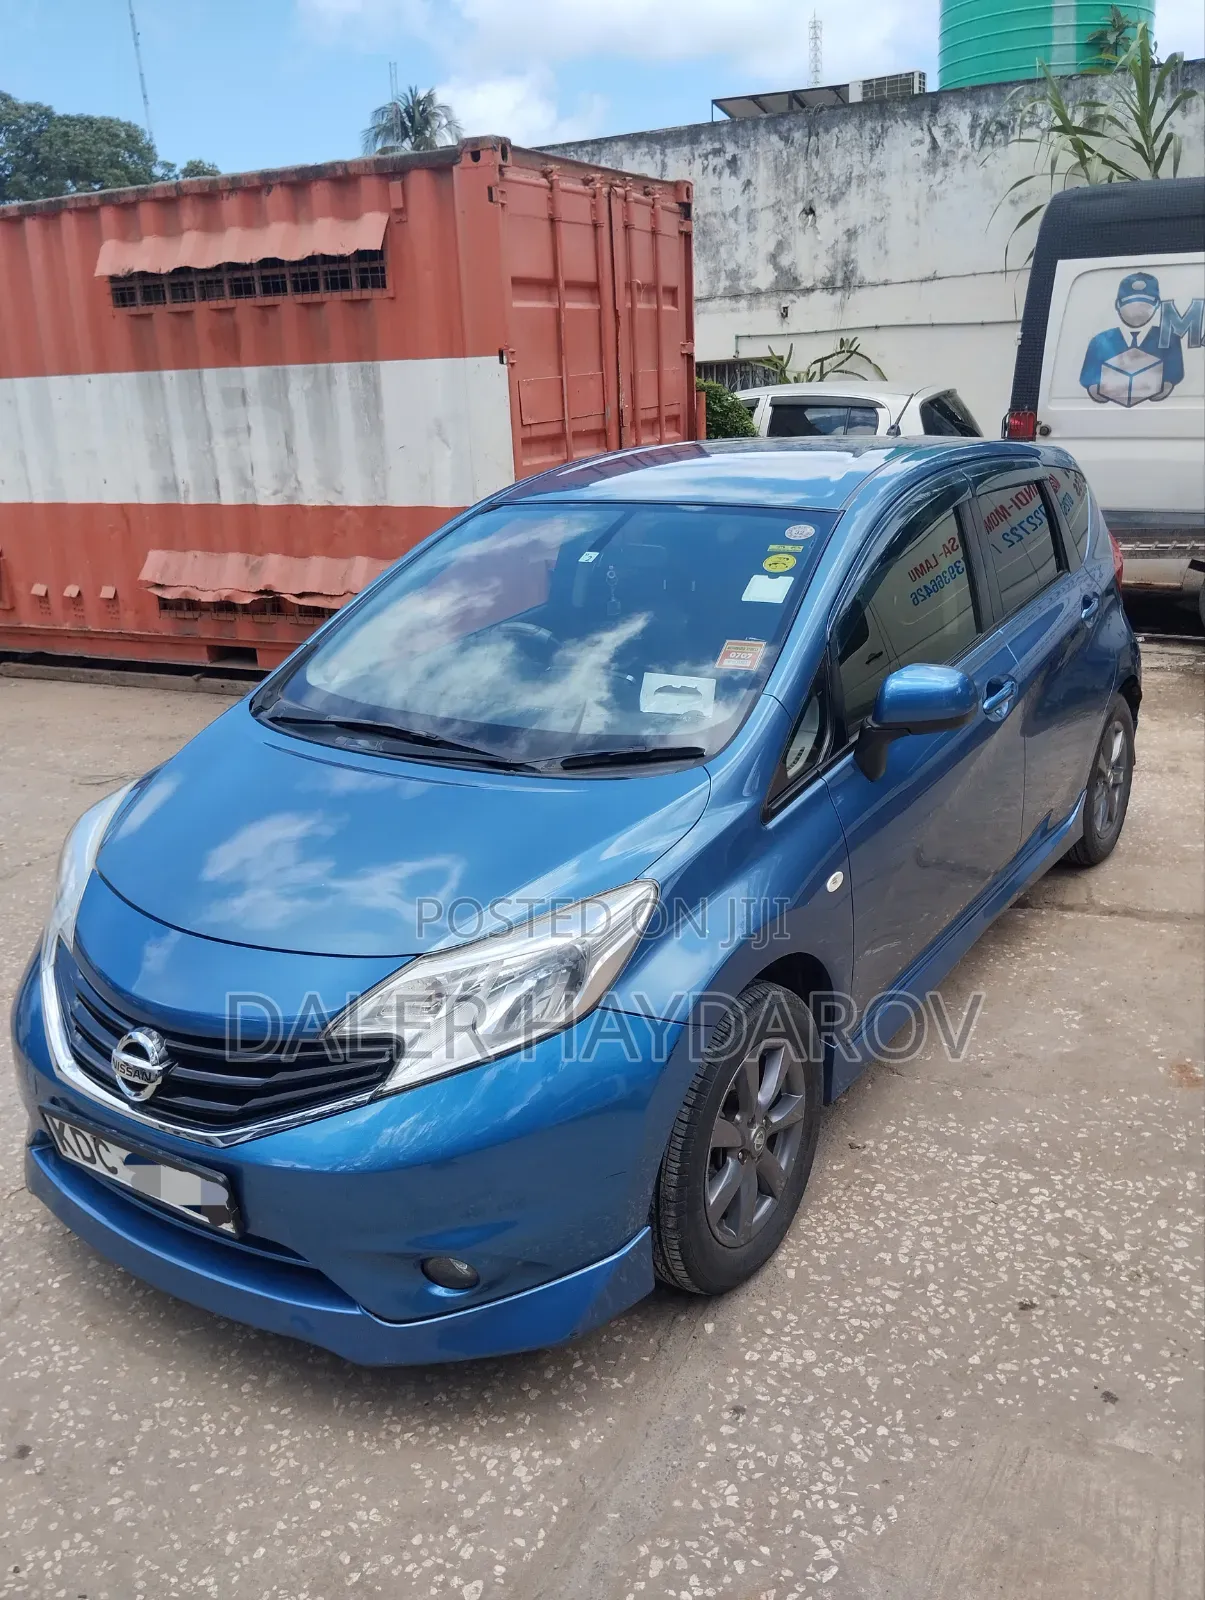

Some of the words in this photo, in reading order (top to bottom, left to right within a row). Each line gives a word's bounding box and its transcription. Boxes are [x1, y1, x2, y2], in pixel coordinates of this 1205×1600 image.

[1158, 298, 1205, 348] M
[112, 1057, 152, 1082] NISSAN
[49, 1119, 119, 1176] KDC
